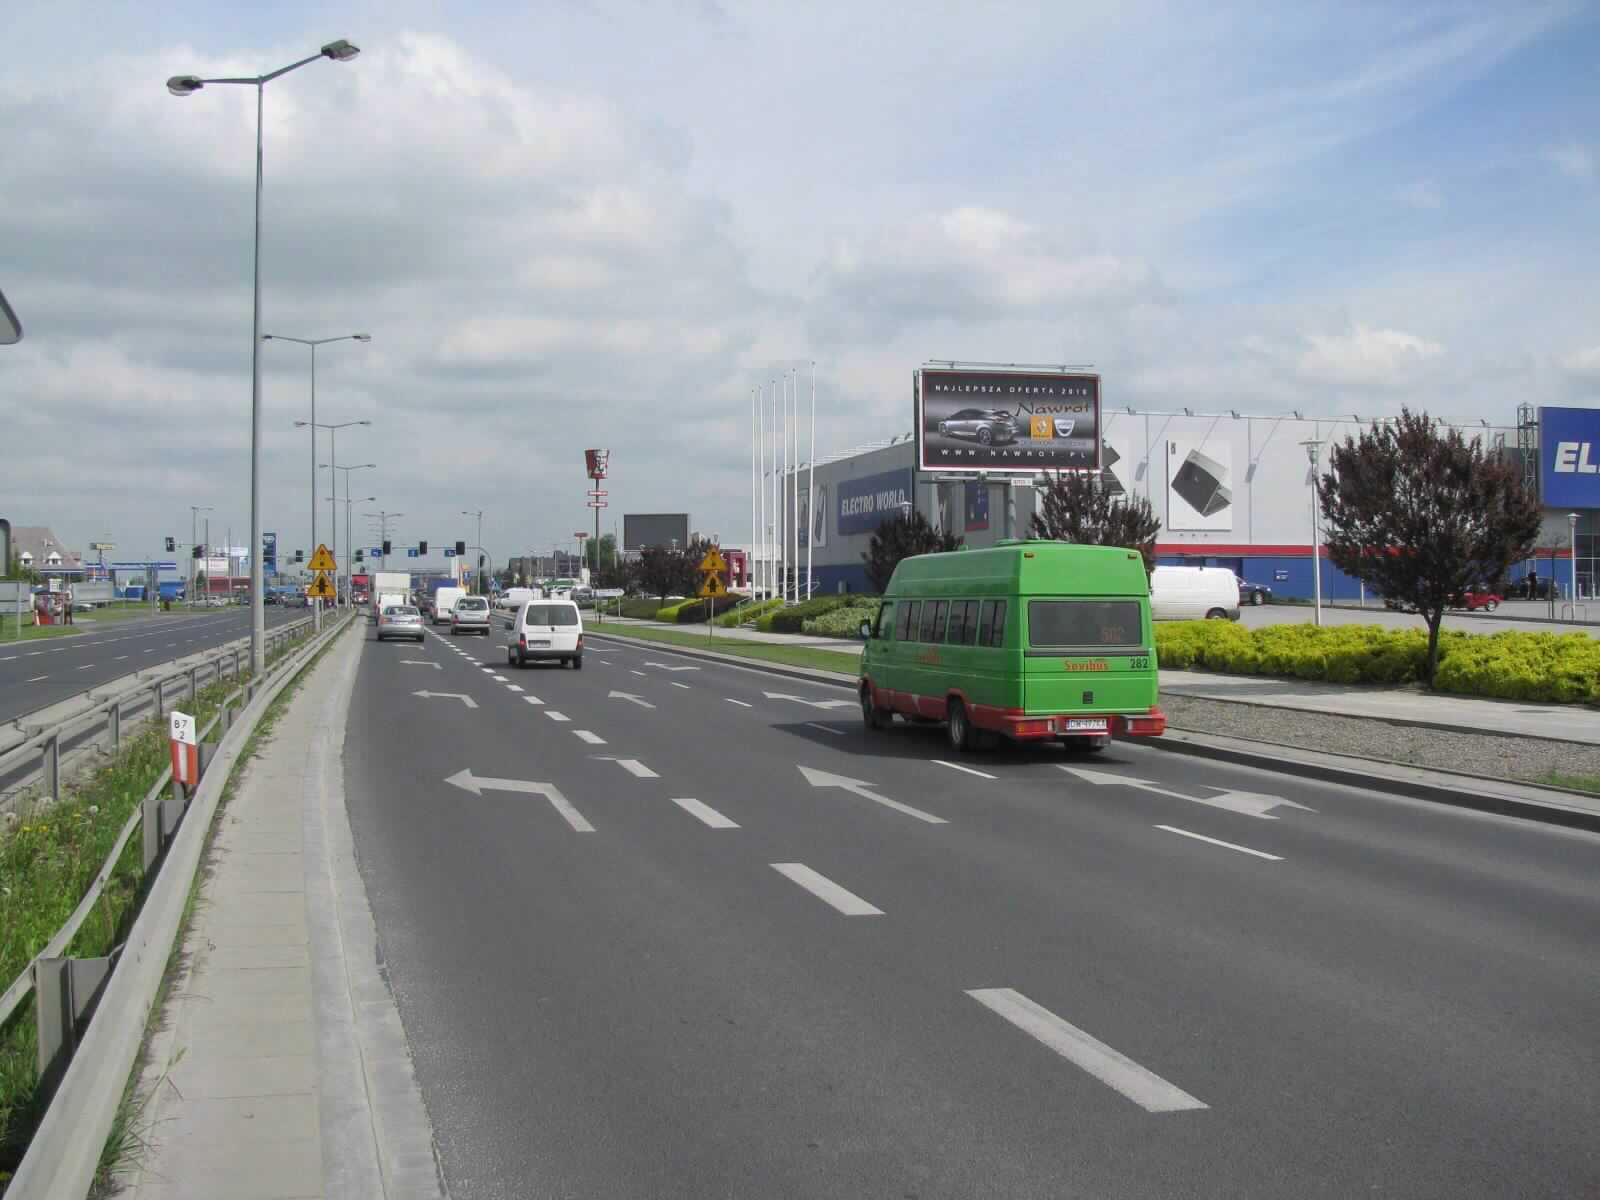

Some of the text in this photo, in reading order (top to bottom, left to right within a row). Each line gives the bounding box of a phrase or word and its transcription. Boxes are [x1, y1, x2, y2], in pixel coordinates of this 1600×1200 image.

[935, 385, 1002, 393] NAJLEPSZA
[1009, 386, 1054, 394] OFERTA
[1015, 401, 1089, 417] Nawrot
[1554, 442, 1600, 473] EL
[841, 488, 905, 516] ELECTRO WORLD
[1130, 657, 1149, 669] 282
